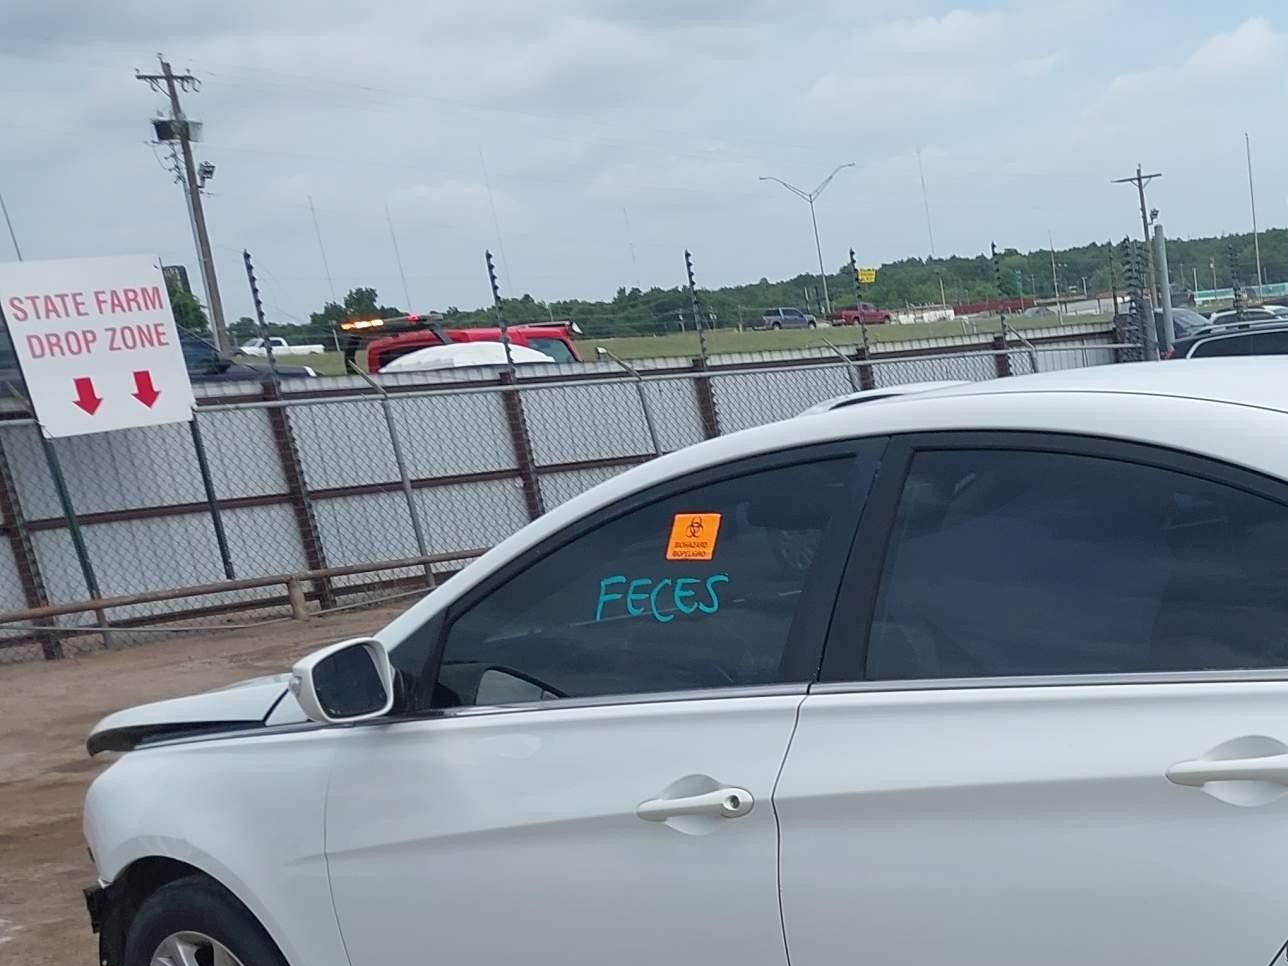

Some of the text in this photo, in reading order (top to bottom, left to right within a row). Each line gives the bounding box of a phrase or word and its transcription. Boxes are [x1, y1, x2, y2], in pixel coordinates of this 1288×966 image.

[9, 286, 164, 323] STATE FARM
[26, 323, 169, 360] DROP ZONE
[596, 574, 729, 622] FECES
